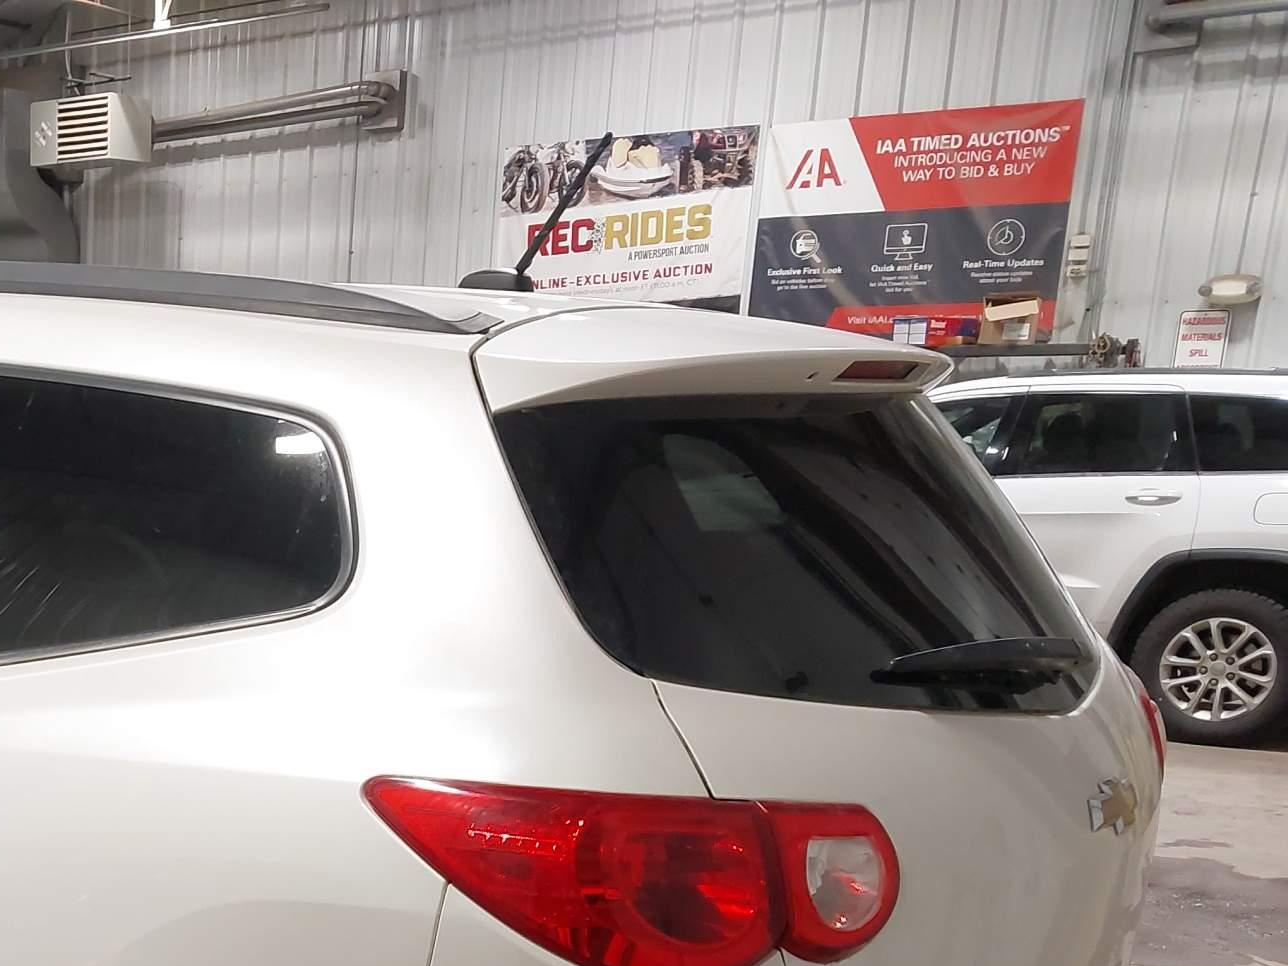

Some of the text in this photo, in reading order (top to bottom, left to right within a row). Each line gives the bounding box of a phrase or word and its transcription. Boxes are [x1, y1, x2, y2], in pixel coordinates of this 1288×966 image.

[876, 138, 907, 154] IAA
[911, 134, 963, 151] TIMED
[894, 146, 1048, 168] INTRODUCING A NEW
[902, 161, 1036, 182] WAY TO BID & BUY
[527, 203, 713, 257] REC RIDES
[627, 243, 710, 261] A POWERSPORT AUCTION
[767, 265, 843, 276] Exclusive First Look
[871, 264, 895, 273] Quick
[913, 262, 934, 272] Easy
[962, 259, 1045, 269] Real-Time Updates
[530, 262, 713, 290] NLINE-EXCLUSIVE AUCTION
[847, 315, 866, 325] Visit
[1180, 332, 1223, 342] MATERIALS
[1189, 348, 1209, 358] SPILL
